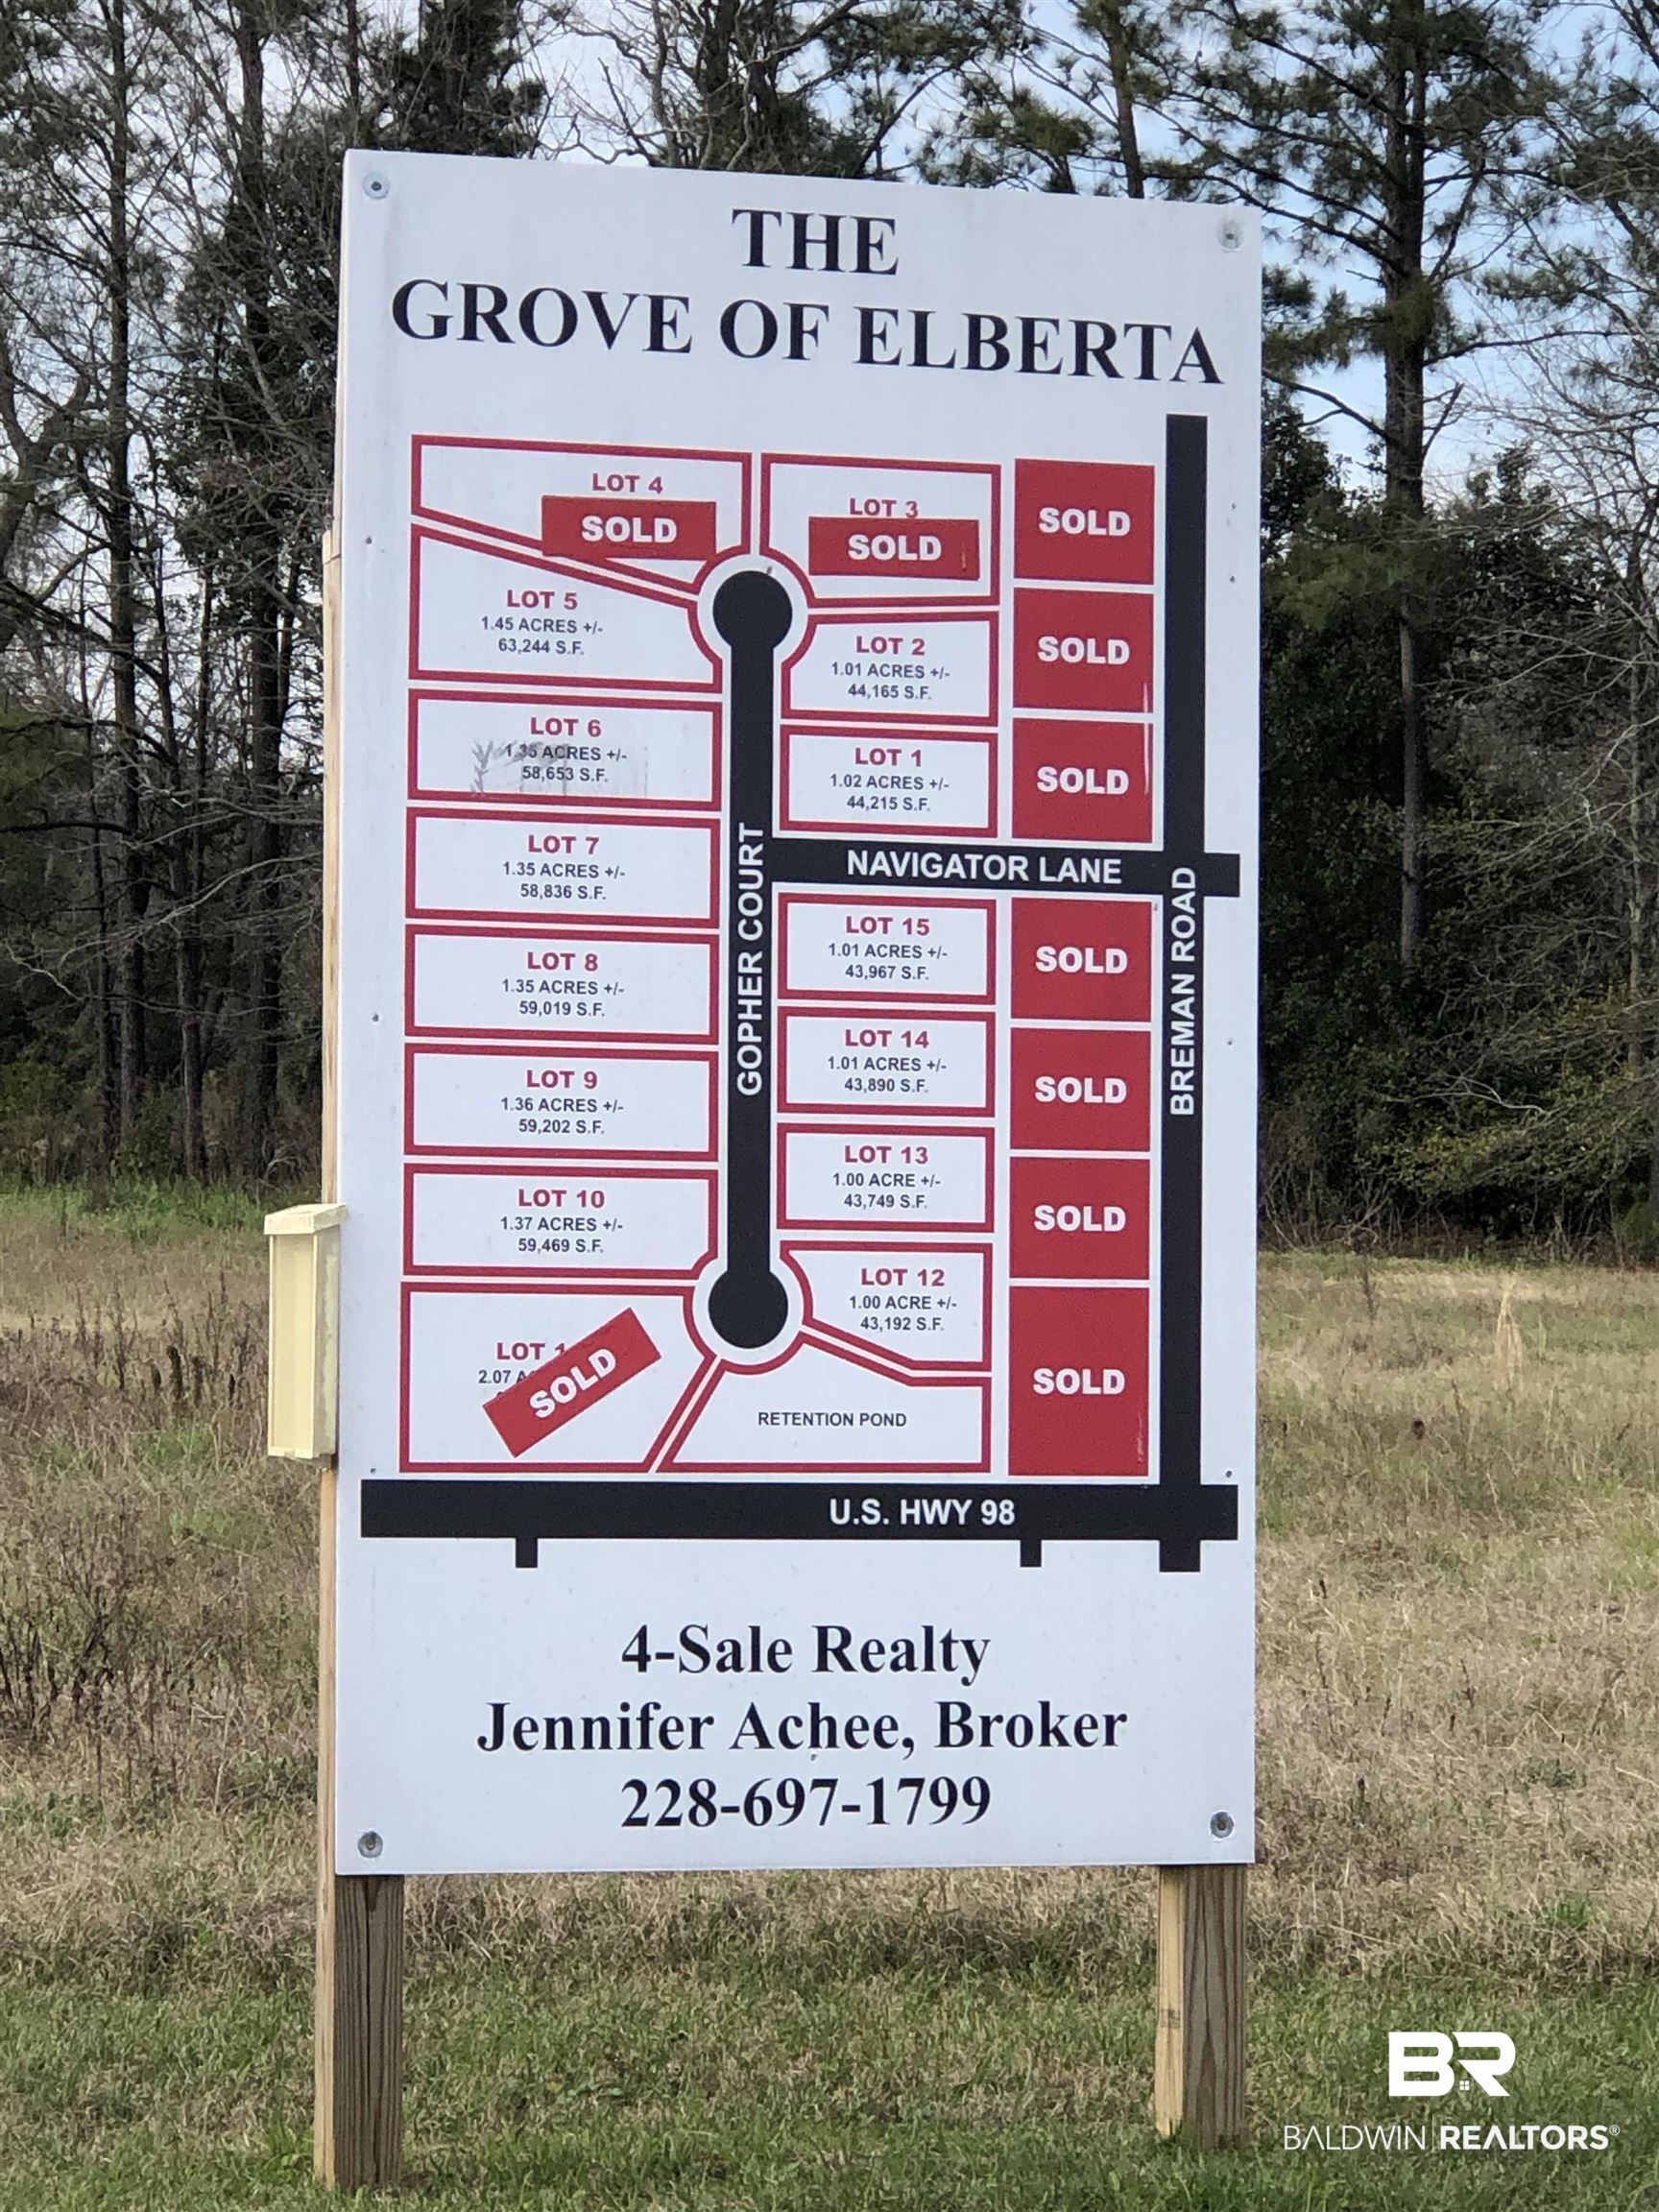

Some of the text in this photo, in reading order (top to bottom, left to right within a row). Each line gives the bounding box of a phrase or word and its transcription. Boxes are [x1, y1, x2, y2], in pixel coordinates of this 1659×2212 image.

[733, 209, 898, 275] THE
[393, 279, 1225, 384] GROVE OF ELBERTA
[592, 473, 662, 493] LOT 4
[850, 498, 918, 517] LOT 3
[582, 516, 677, 542] SOLD
[1040, 508, 1130, 536] SOLD
[849, 535, 941, 560] SOLD
[507, 589, 577, 610] LOT 5
[482, 616, 602, 634] 1.45 ACRES +/-
[498, 638, 584, 655] 63,244 S.F.
[856, 637, 925, 656] LOT 2
[1038, 637, 1129, 664] SOLD
[832, 661, 950, 679] 1.01 ACRES +/-
[848, 684, 931, 699] 44,165 S.F.
[531, 717, 601, 737] LOT 6
[504, 743, 627, 761] 1.35 ACRES +/-
[855, 748, 921, 767] LOT 1
[522, 766, 608, 781] 58,653 S.F.
[830, 774, 949, 790] 1.02 ACRES +/-
[1038, 767, 1128, 794] SOLD
[847, 796, 930, 810] 44,215 S.F.
[529, 835, 599, 854] LOT 7
[504, 861, 625, 878] 1.35 ACRES +/-
[847, 850, 1122, 884] NAVIGATOR LANE
[520, 883, 607, 900] 58,836 S.F.
[847, 916, 929, 936] LOT 15
[737, 823, 763, 1095] GOPHER COURT
[829, 943, 947, 959] 1.01 ACRES +/-
[1036, 947, 1127, 974] SOLD
[528, 952, 598, 972] LOT 8
[846, 965, 928, 979] 43,967 S.F.
[502, 978, 624, 996] 1.35 ACRES +/-
[1170, 868, 1195, 1115] BREMAN ROAD
[519, 1000, 604, 1017] 59,019 S.F.
[846, 1029, 928, 1048] LOT 14
[829, 1056, 946, 1071] 1.01 ACRES +/-
[527, 1070, 597, 1089] LOT 9
[845, 1078, 928, 1093] 43,890 S.F.
[1035, 1076, 1126, 1103] SOLD
[501, 1097, 623, 1113] 1.36 ACRES +/-
[519, 1118, 604, 1134] 59,202 S.F.
[845, 1145, 927, 1164] LOT 13
[833, 1173, 940, 1188] 1.00 ACRE +/-
[519, 1190, 604, 1208] LOT 10
[844, 1193, 926, 1210] 43,749 S.F.
[501, 1216, 622, 1232] 1.37 ACRES +/-
[1034, 1205, 1125, 1231] SOLD
[518, 1238, 603, 1254] 59,469 S.F.
[861, 1268, 945, 1286] LOT 12
[850, 1295, 956, 1310] 1.00 ACRE +/-
[860, 1316, 944, 1332] 43,192 S.F.
[497, 1343, 545, 1360] LOT
[479, 1370, 511, 1383] 2.07
[529, 1348, 616, 1419] SOLD
[1034, 1368, 1124, 1394] SOLD
[758, 1412, 906, 1427] RETENTION POND
[830, 1499, 1015, 1525] U.S. HWY 98
[622, 1624, 991, 1686] 4-Sale Realty
[478, 1701, 1127, 1760] Jennifer Achee, Broker
[622, 1776, 990, 1827] 228-697-1799
